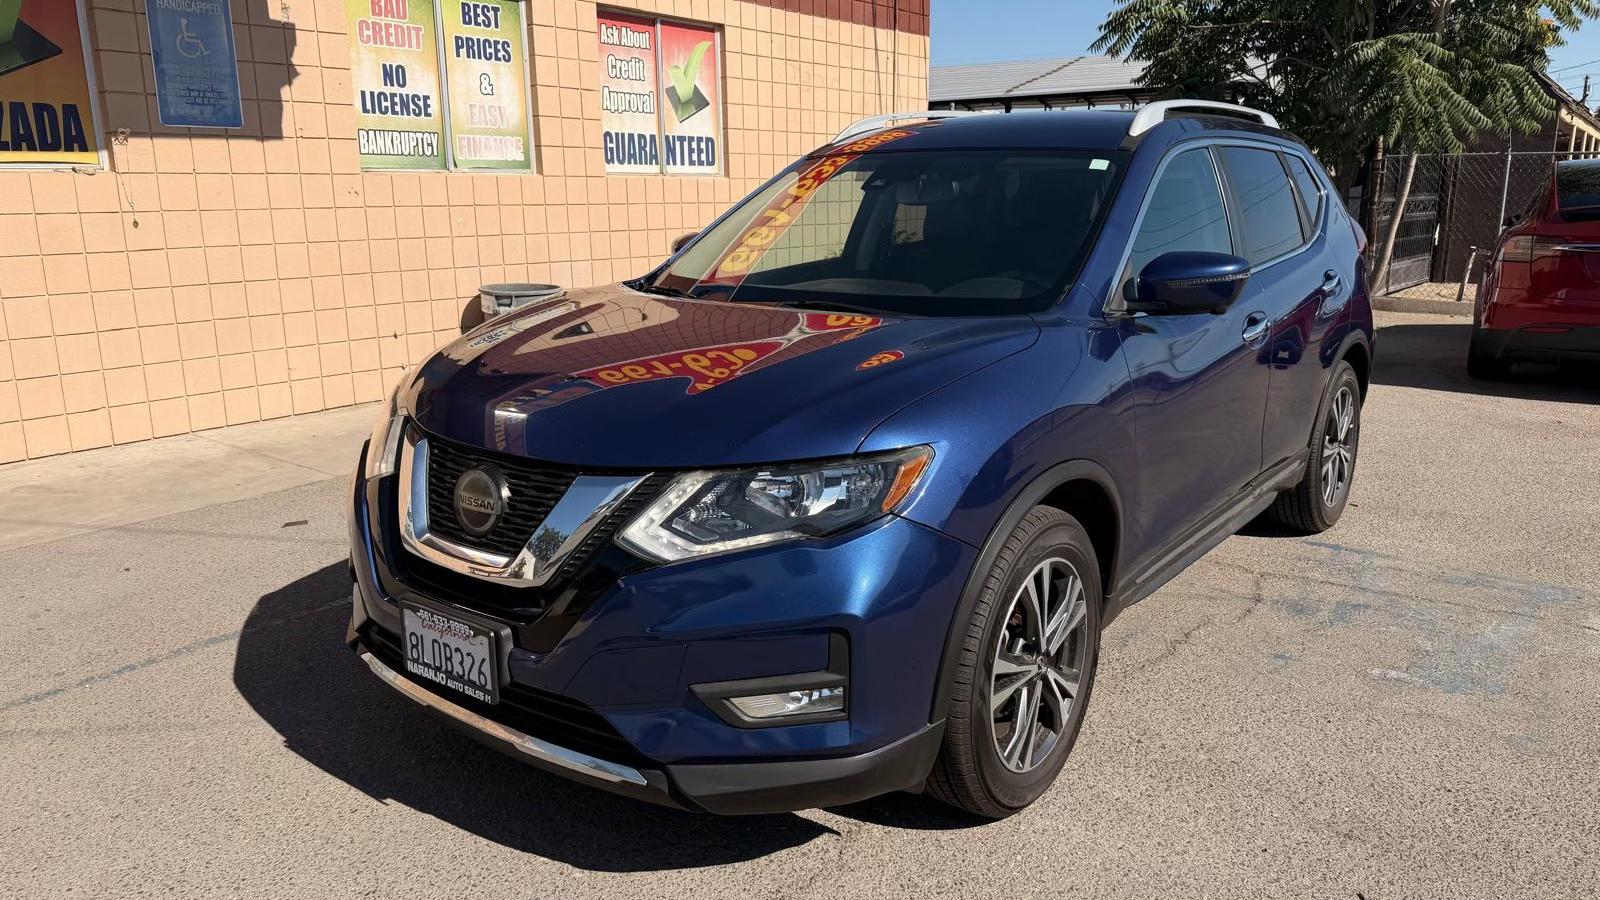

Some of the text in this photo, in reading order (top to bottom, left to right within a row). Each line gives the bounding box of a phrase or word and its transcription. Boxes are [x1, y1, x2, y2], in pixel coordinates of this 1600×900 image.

[157, 0, 221, 15] HANDICAPPED
[370, 0, 408, 20] BAD
[461, 2, 501, 29] BEST
[358, 20, 423, 50] CREDIT
[600, 23, 651, 50] Ask About
[454, 36, 512, 63] PRICES
[382, 63, 407, 88] NO
[607, 54, 645, 81] Credit
[479, 73, 494, 96] &
[360, 90, 432, 118] LICENSE
[602, 86, 654, 114] Approval
[469, 103, 508, 128] EASY
[358, 129, 439, 157] BANKRUPTCY
[603, 131, 716, 166] GUARANTEED
[460, 494, 495, 511] NISSAN
[407, 660, 446, 685] NARANJO
[447, 678, 464, 692] AUTO
[464, 685, 484, 701] SALES
